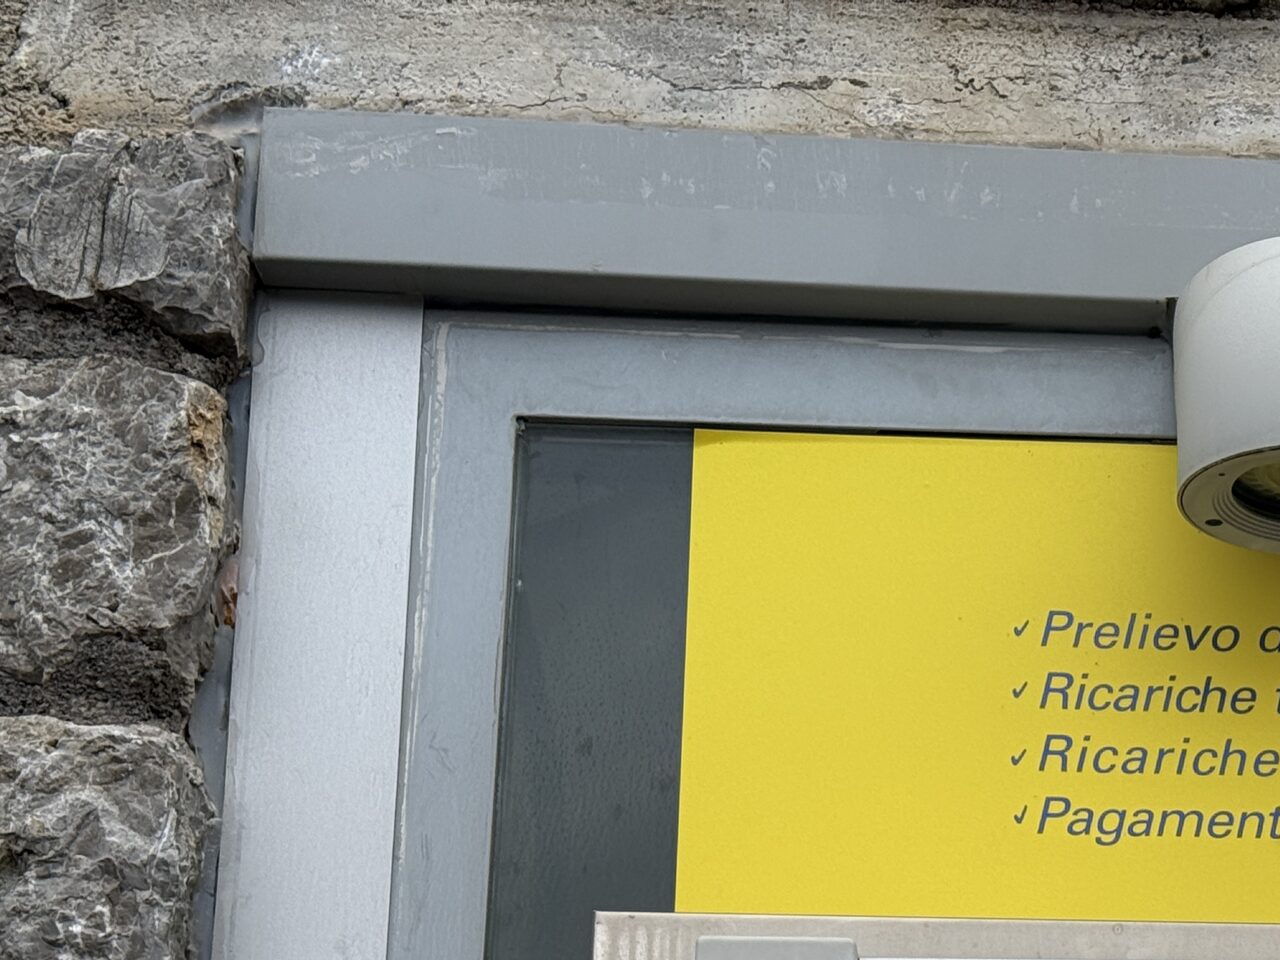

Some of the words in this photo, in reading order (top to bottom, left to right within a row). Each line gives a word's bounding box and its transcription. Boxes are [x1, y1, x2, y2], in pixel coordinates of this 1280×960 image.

[1040, 610, 1239, 653] Prelievo
[1039, 672, 1257, 715] Ricariche
[1038, 735, 1280, 776] Ricariche
